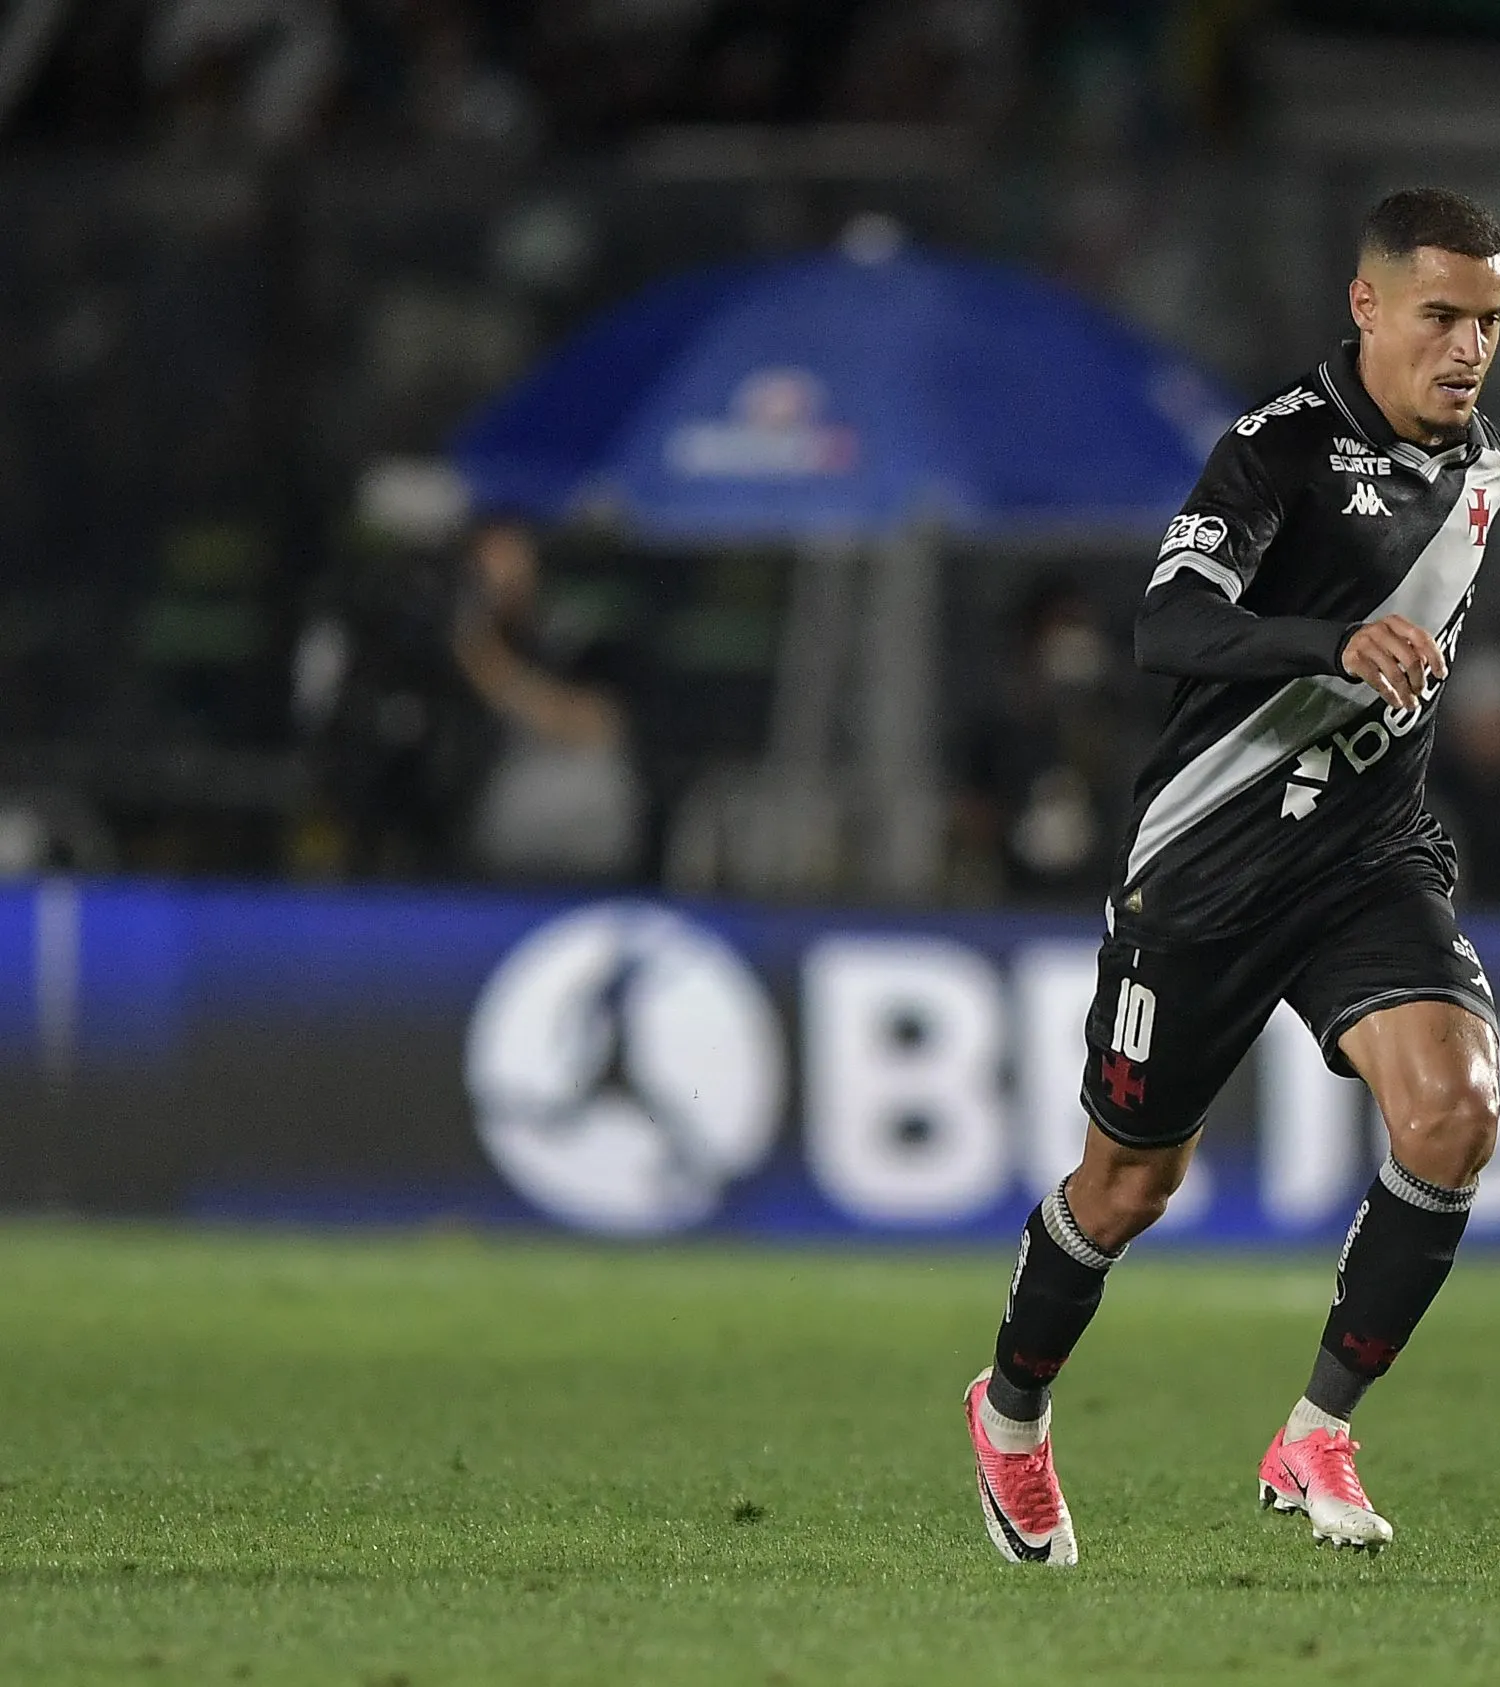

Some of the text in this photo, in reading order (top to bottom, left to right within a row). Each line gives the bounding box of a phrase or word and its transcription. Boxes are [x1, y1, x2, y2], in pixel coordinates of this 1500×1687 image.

[1332, 436, 1375, 455] VIVA
[1329, 454, 1392, 476] SORTE
[1110, 977, 1156, 1063] 10
